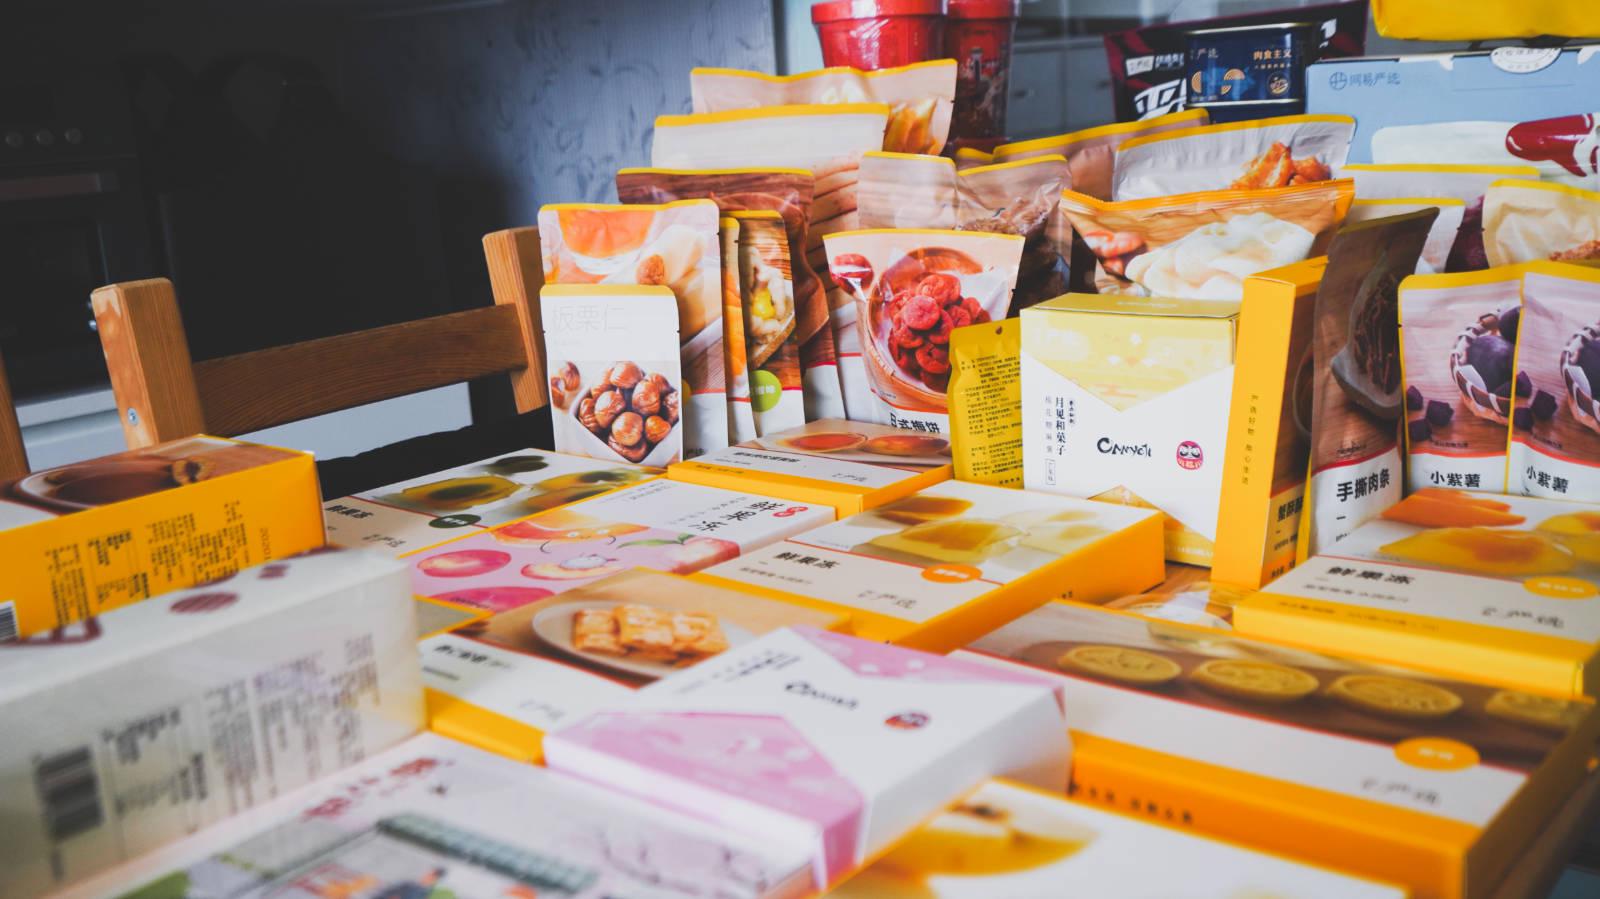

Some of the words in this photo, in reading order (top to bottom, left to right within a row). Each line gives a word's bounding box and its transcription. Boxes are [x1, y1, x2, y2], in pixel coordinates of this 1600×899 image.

[1252, 48, 1292, 60] 肉食主义
[553, 304, 628, 334] 板栗仁
[1336, 468, 1391, 502] 手撕肉条
[1430, 471, 1481, 489] 小紫薯
[1525, 465, 1569, 494] 小紫薯
[774, 550, 842, 570] 鲜果冻
